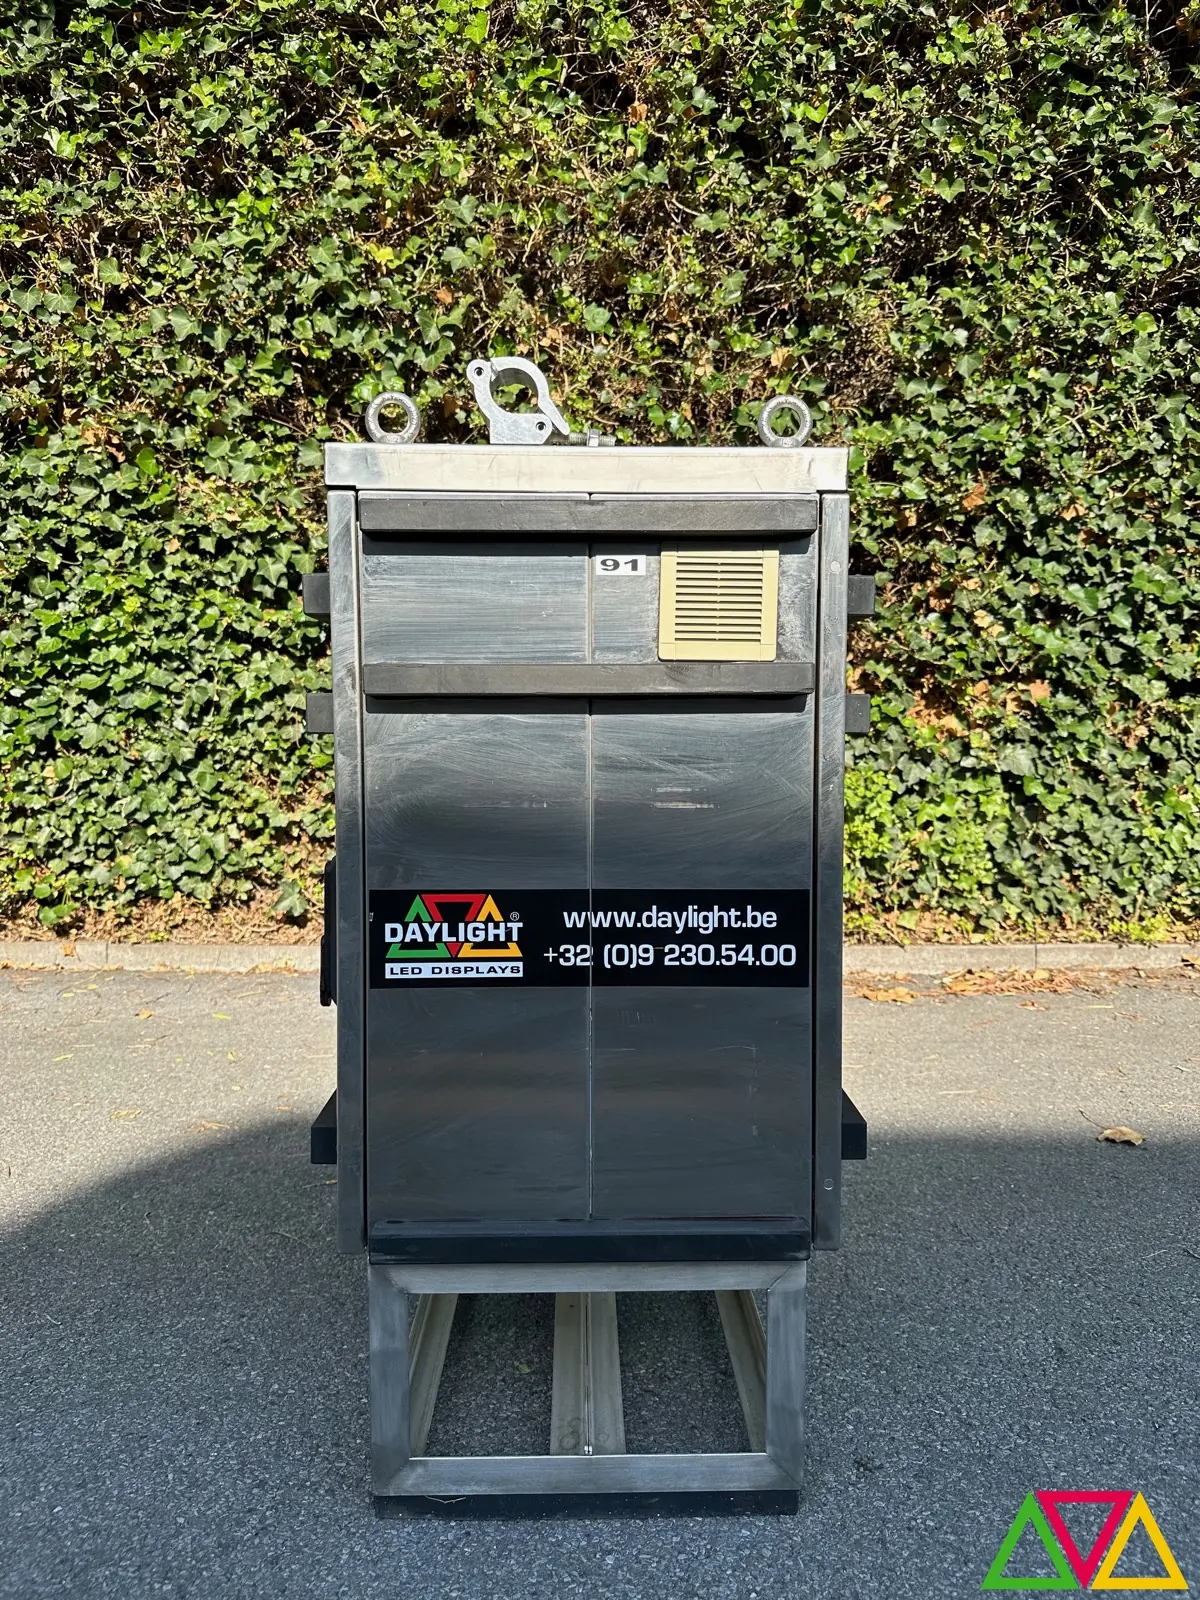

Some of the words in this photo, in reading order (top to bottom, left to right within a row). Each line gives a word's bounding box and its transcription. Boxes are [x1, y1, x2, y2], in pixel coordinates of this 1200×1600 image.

[599, 558, 640, 572] 91
[563, 905, 778, 935] www.daylight.be
[384, 922, 524, 943] DAYLIGHT
[543, 944, 594, 967] +32
[603, 944, 655, 969] (0)9
[663, 944, 797, 966] 230.54.00
[389, 966, 423, 976] LED
[431, 965, 521, 975] DISPLAYS
